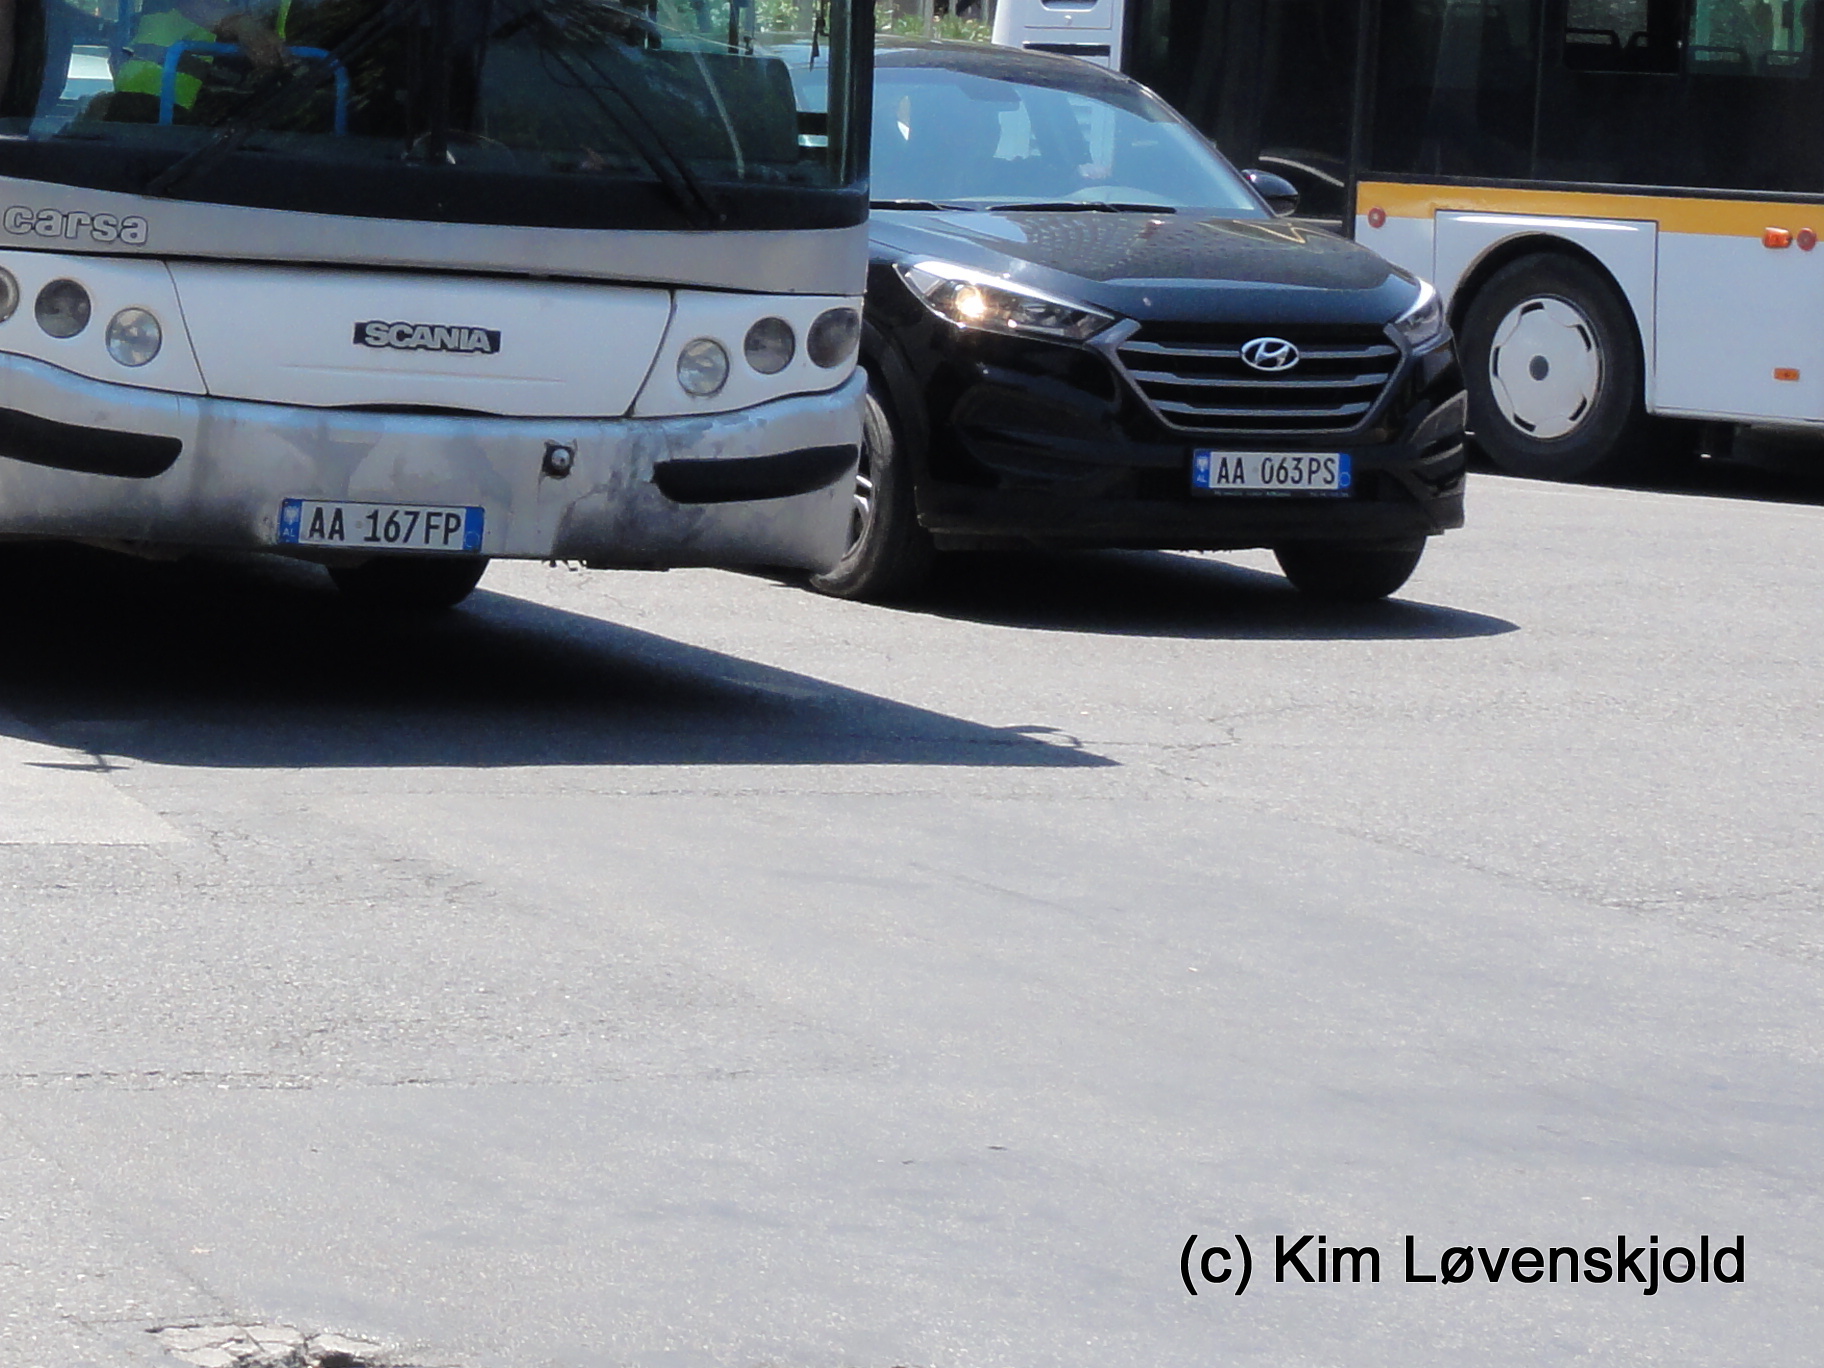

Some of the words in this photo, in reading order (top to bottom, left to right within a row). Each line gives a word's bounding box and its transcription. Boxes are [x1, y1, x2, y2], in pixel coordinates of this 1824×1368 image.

[3, 205, 149, 246] carsa
[364, 322, 492, 353] SCANIA
[1217, 457, 1246, 485] AA
[1261, 457, 1337, 485] 063PS
[282, 527, 296, 538] AL
[308, 506, 346, 542] AA
[363, 508, 462, 546] 167FP
